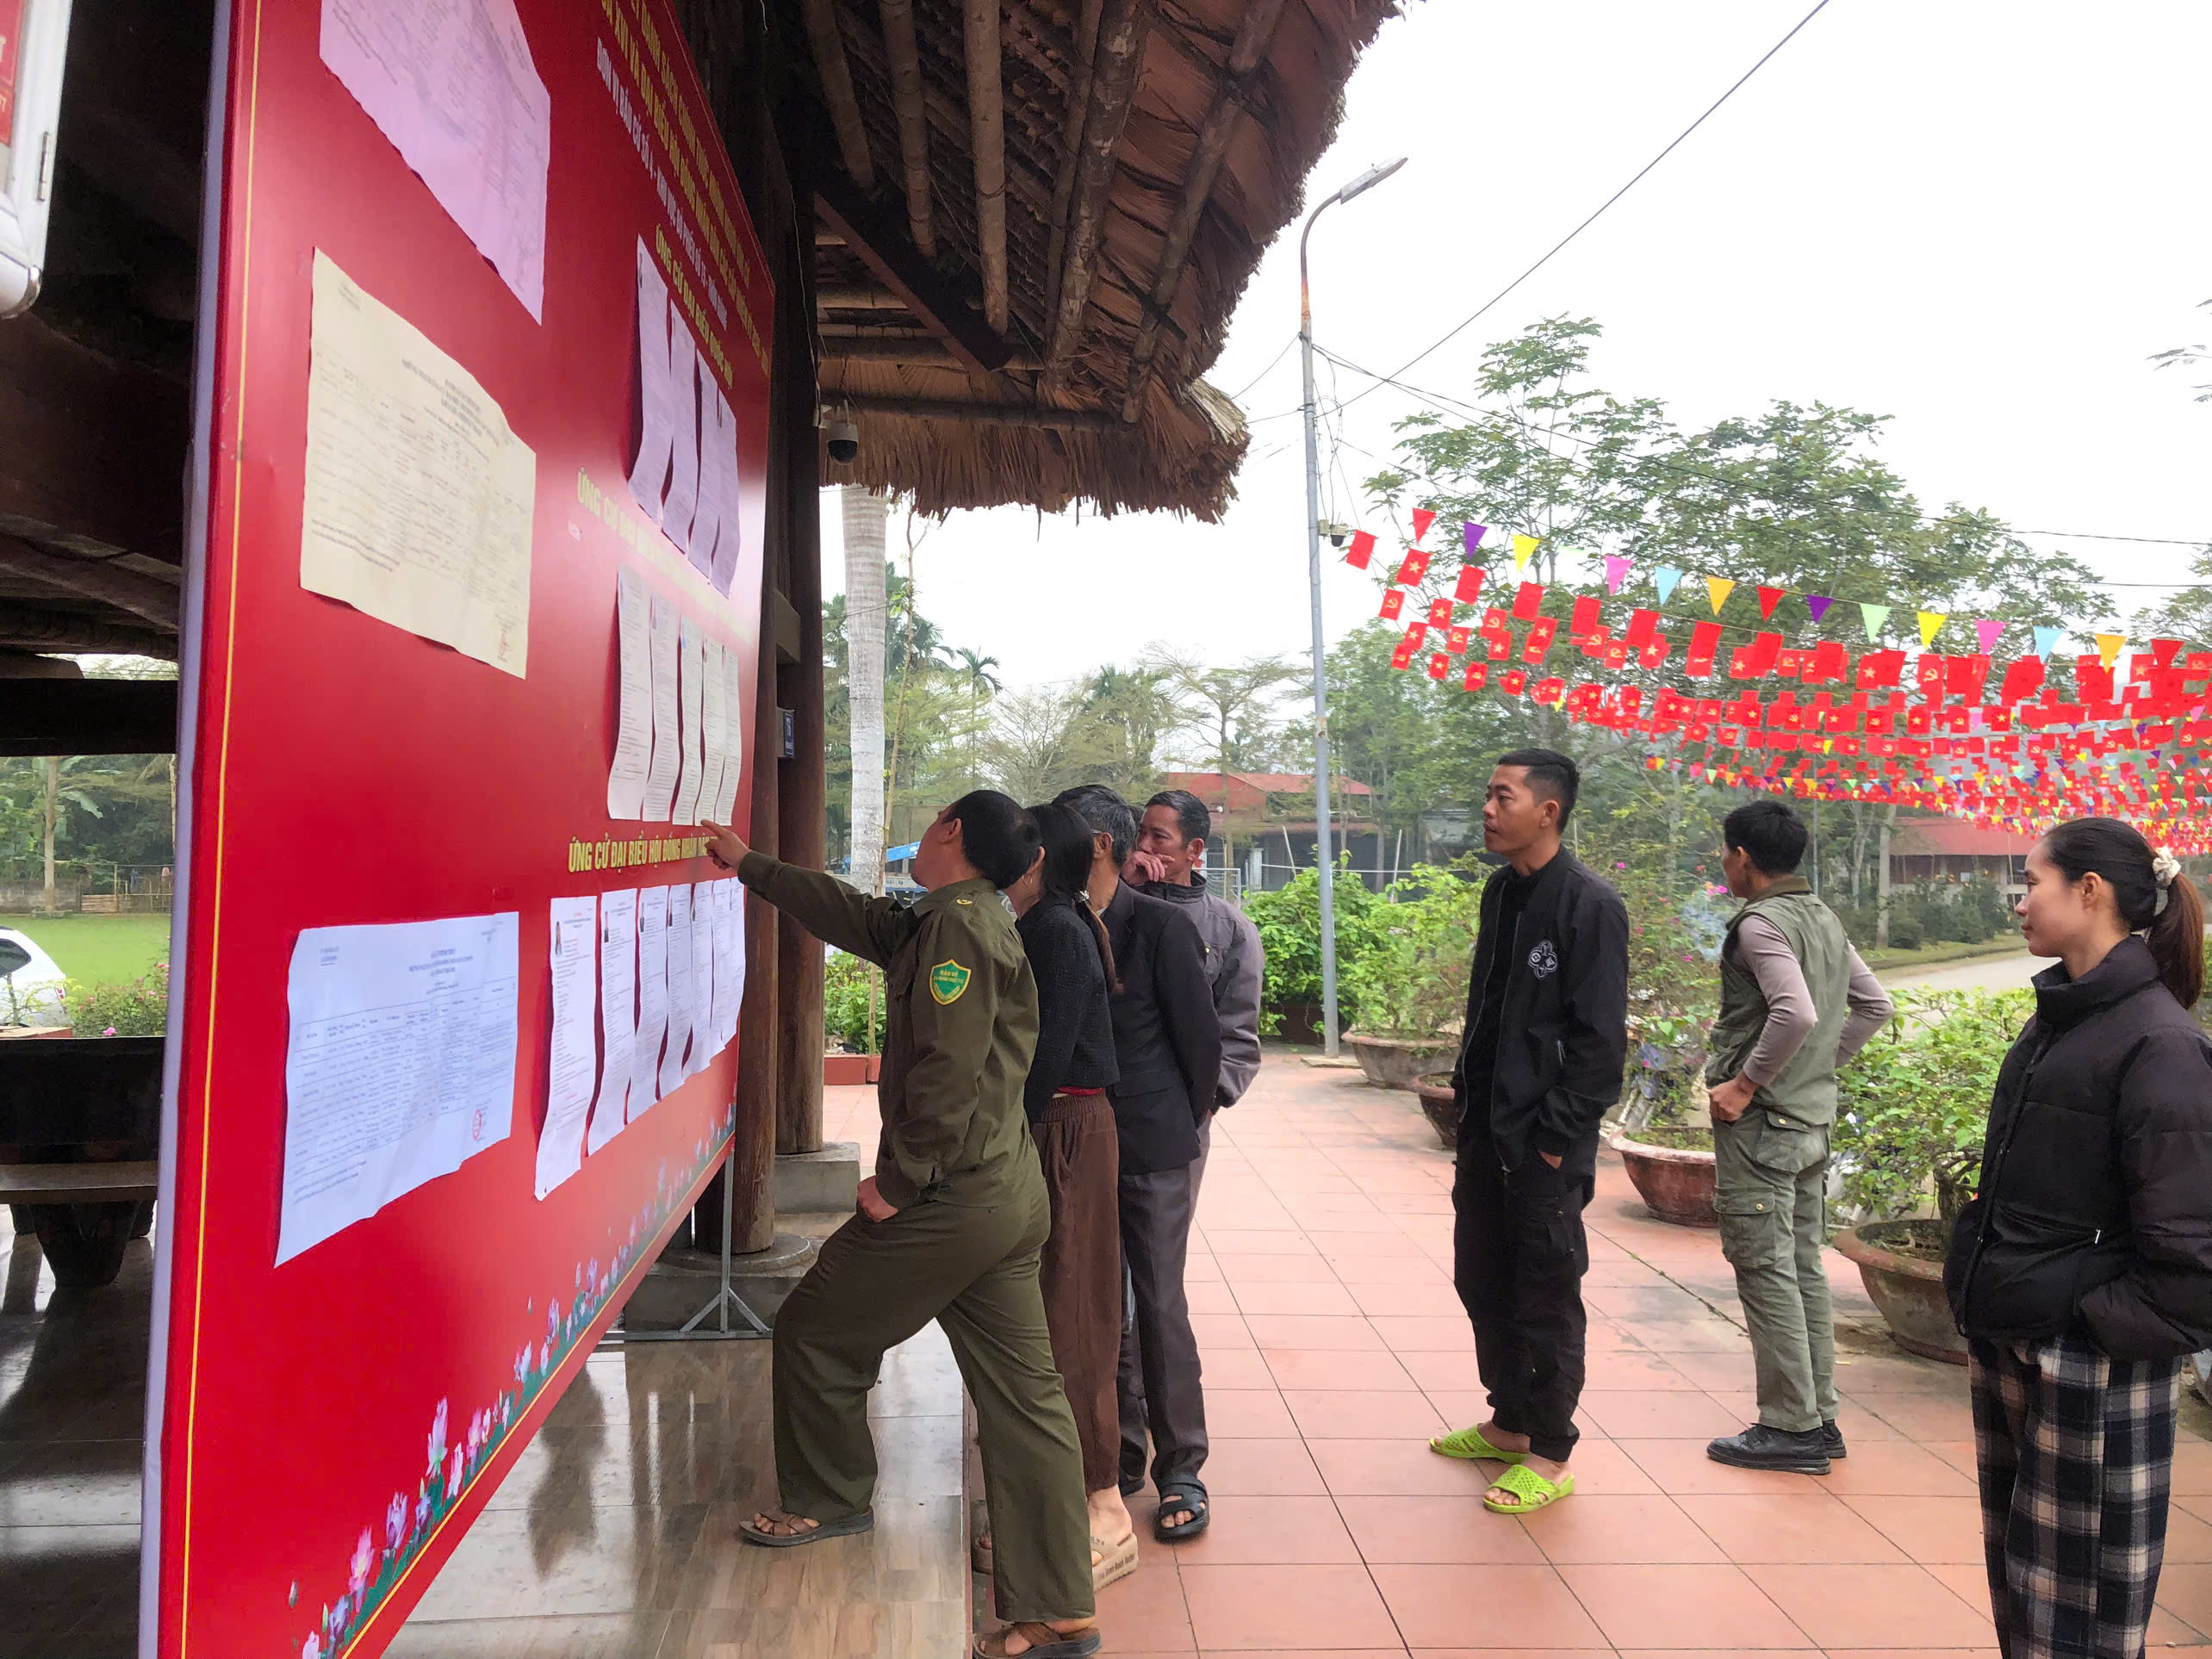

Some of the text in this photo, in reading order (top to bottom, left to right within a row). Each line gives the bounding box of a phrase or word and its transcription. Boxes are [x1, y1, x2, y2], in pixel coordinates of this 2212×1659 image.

[569, 836, 593, 873] ỨNG
[595, 832, 611, 870] CỬ
[611, 841, 627, 873] ĐẠI
[628, 830, 648, 866] BIỂU
[649, 835, 662, 868] HỘI
